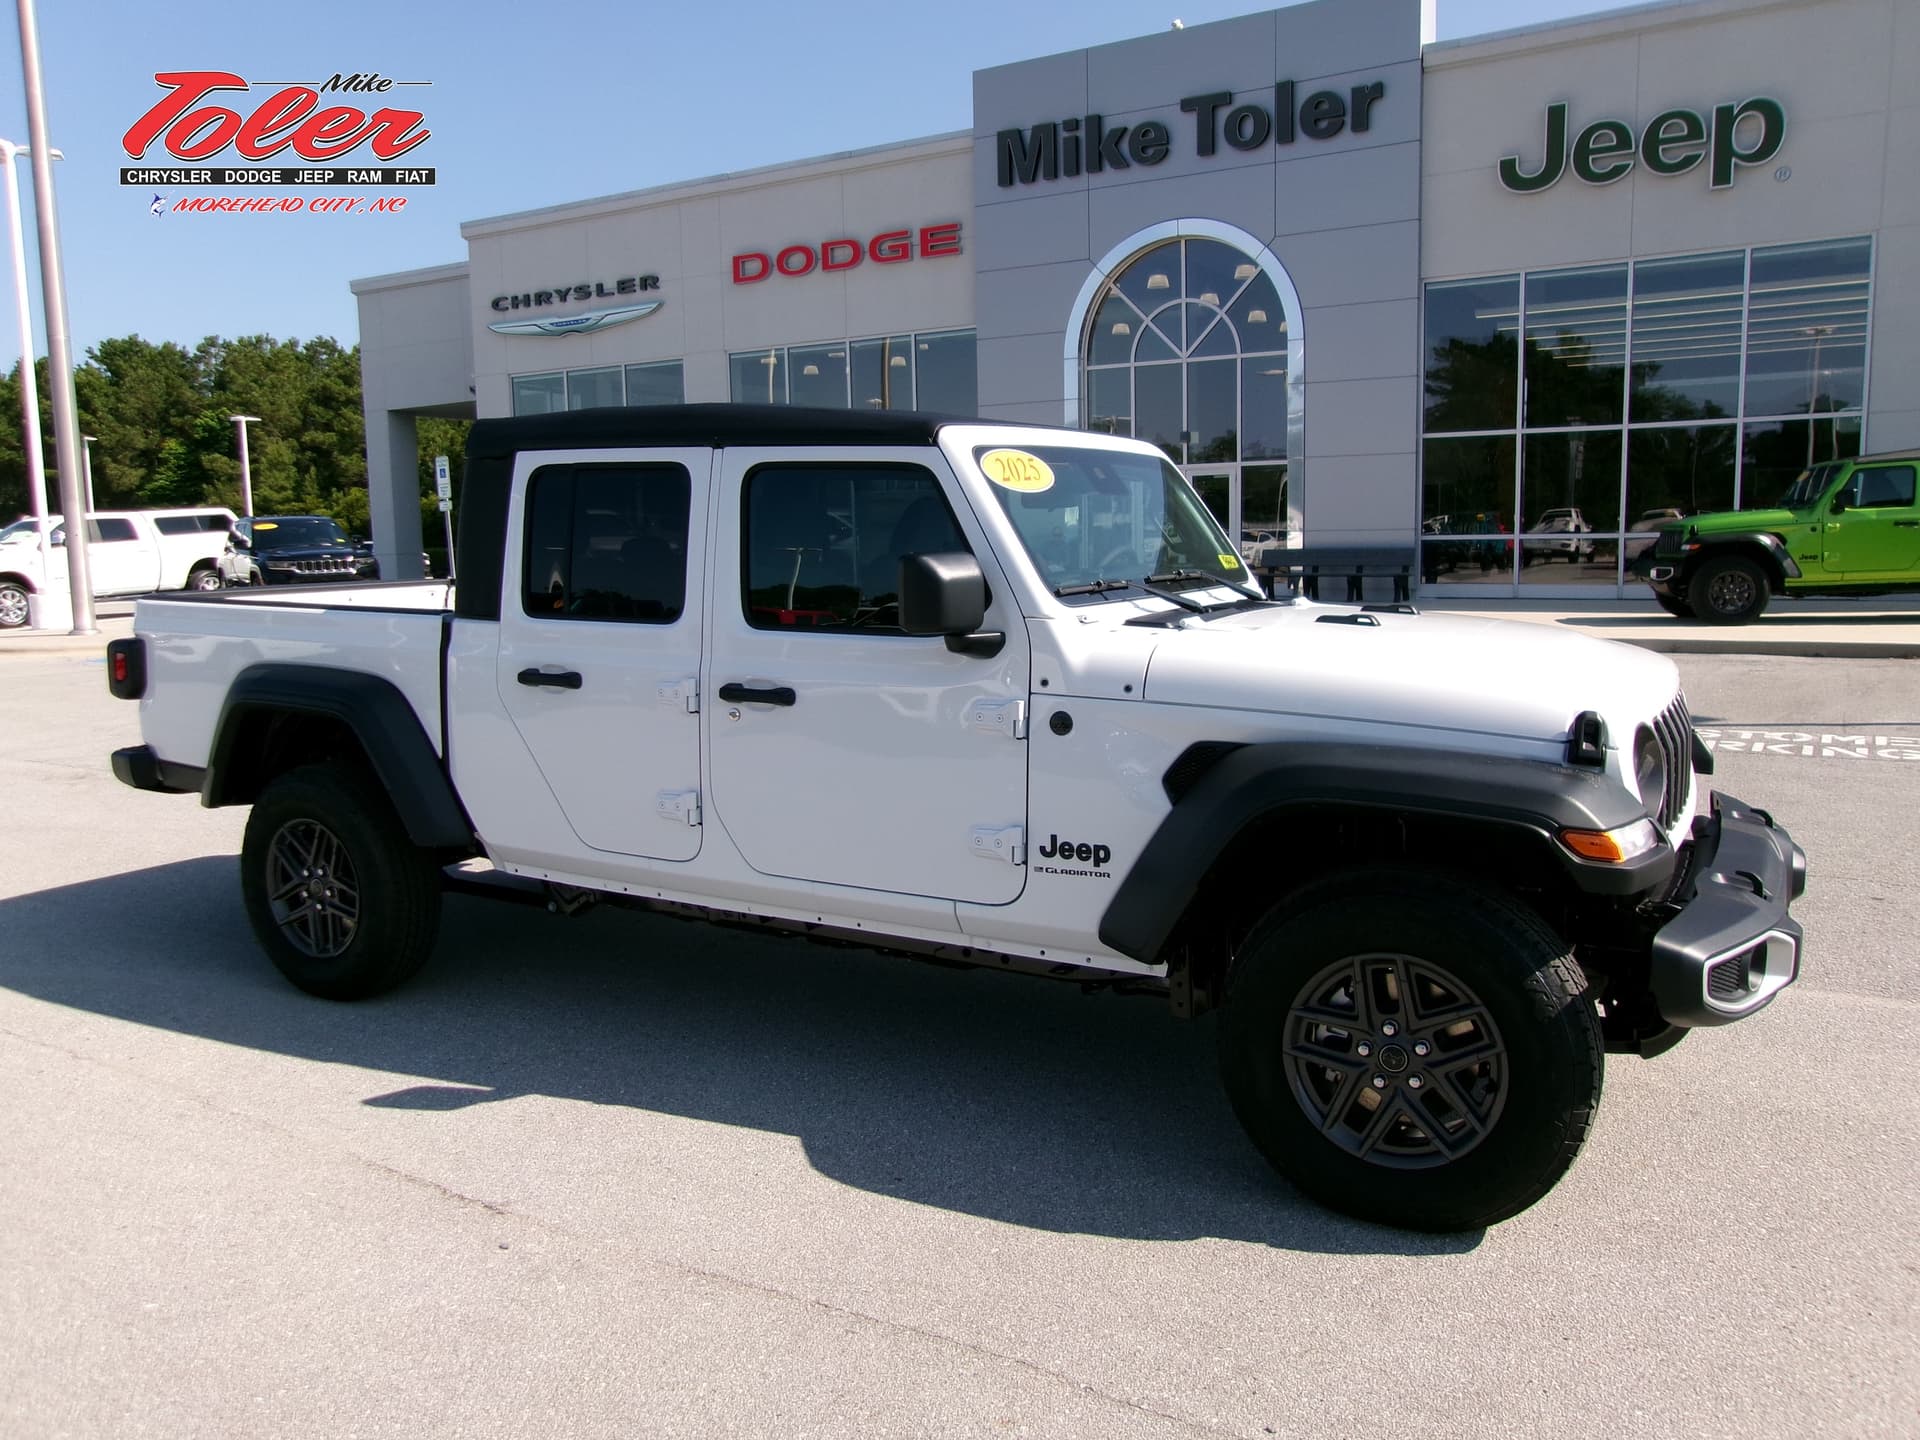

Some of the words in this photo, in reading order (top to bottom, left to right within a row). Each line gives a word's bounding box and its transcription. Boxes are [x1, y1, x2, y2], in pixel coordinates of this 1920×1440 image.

[996, 113, 1171, 188] Mike
[1179, 79, 1384, 157] Toler
[1497, 96, 1787, 194] Jeep
[731, 222, 963, 285] DODGE
[490, 273, 661, 313] CHRYSLER
[994, 456, 1042, 483] 2025
[1039, 833, 1112, 868] Jeep
[1044, 866, 1112, 879] GLADIATOR
